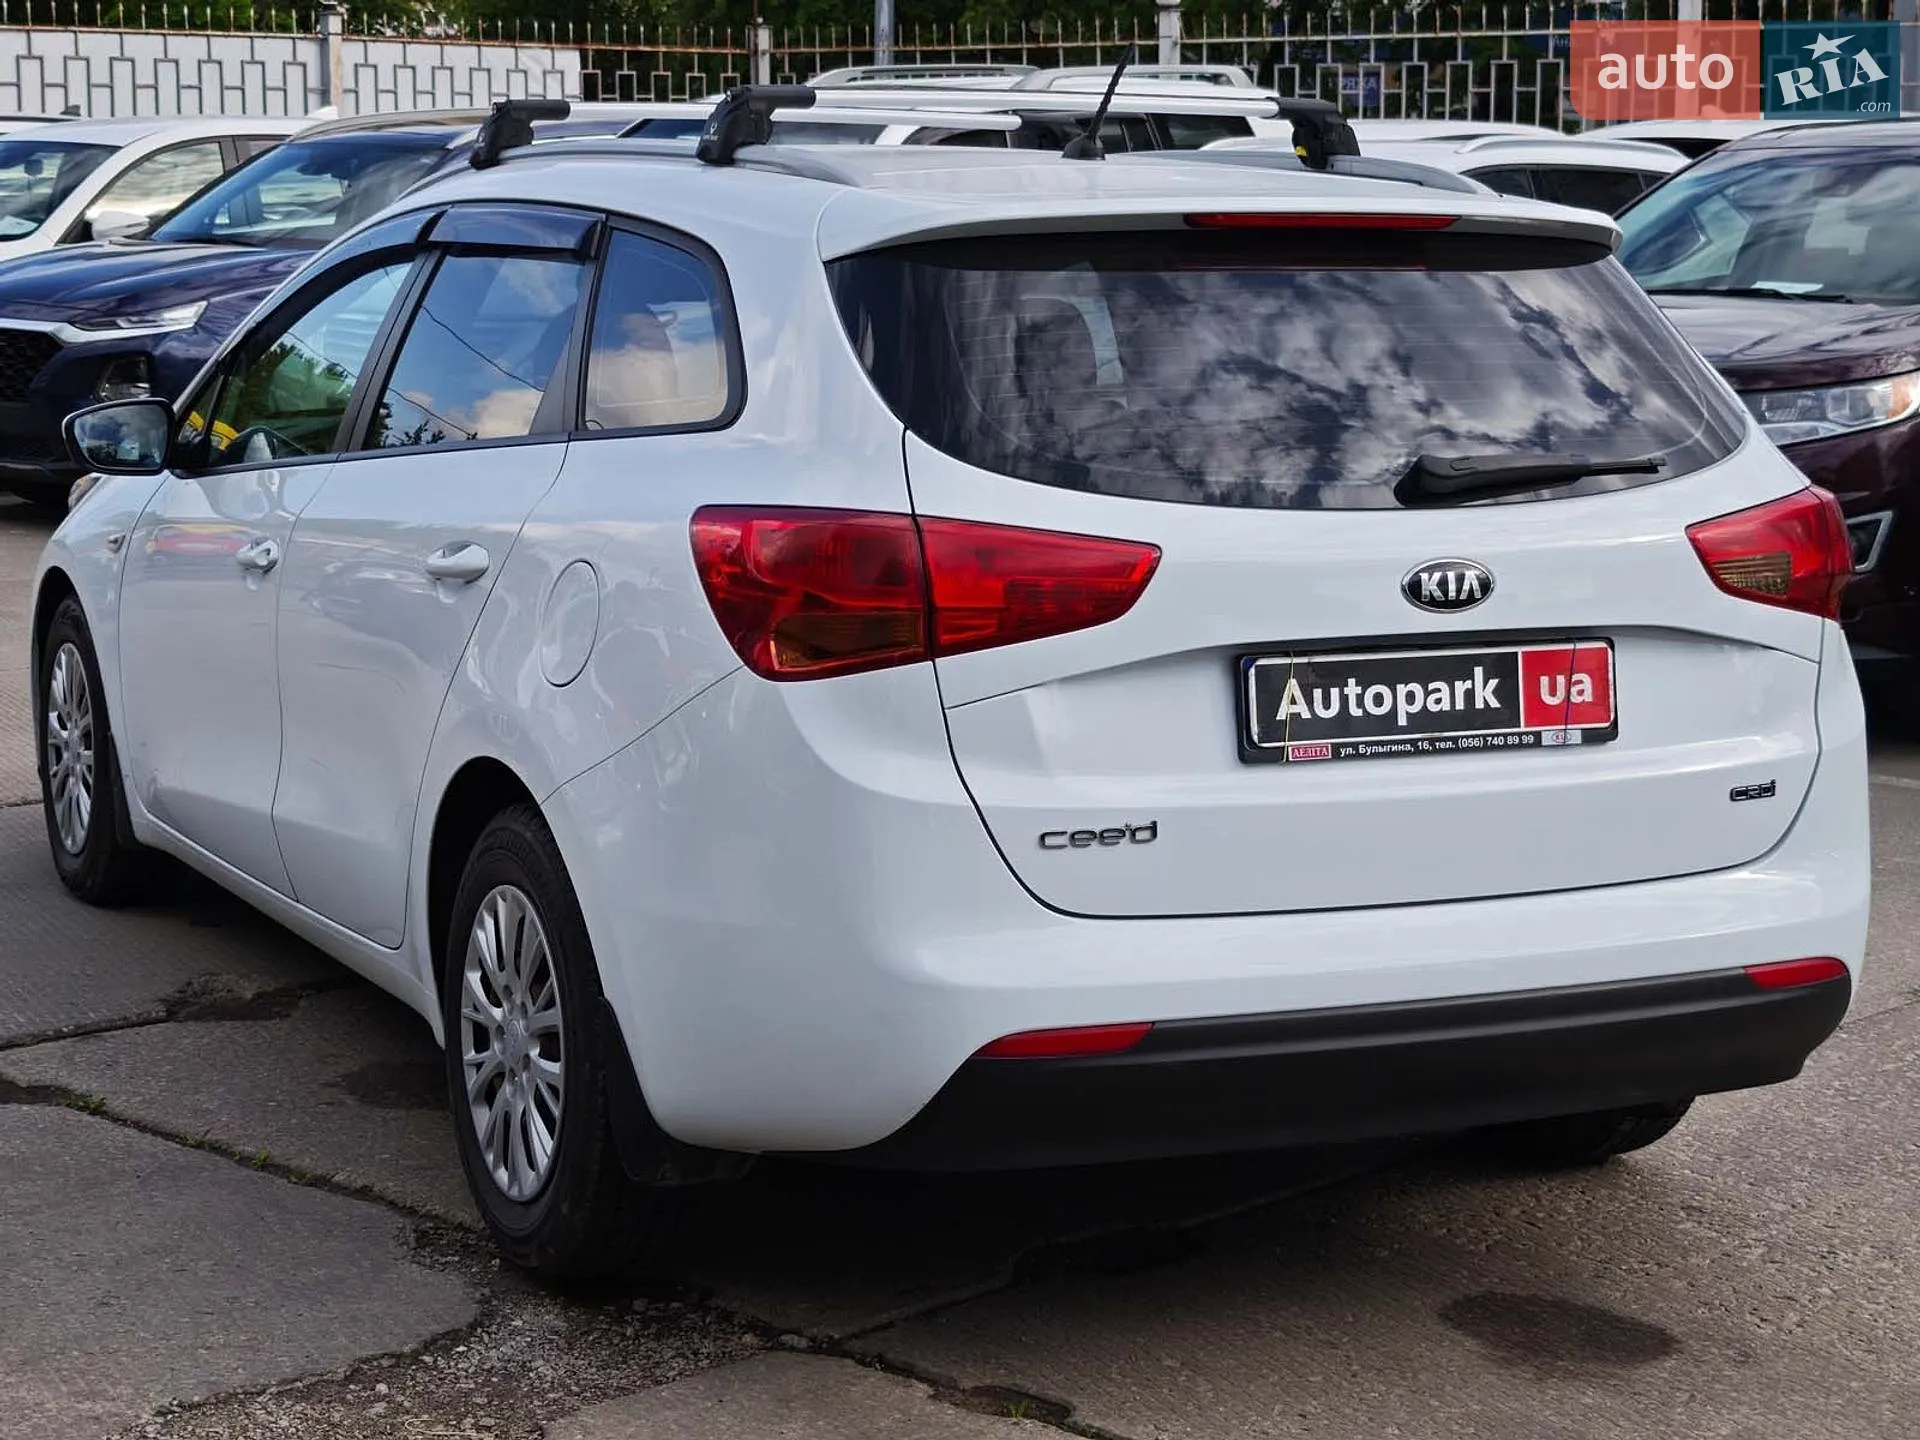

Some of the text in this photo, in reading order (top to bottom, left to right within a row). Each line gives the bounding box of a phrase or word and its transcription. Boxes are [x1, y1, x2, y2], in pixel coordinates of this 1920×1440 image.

[1419, 570, 1482, 601] KIA
[1275, 666, 1594, 726] Autopark ua
[1340, 734, 1534, 757] ул. Булыгина, 16, тел. (056) 740 89 99
